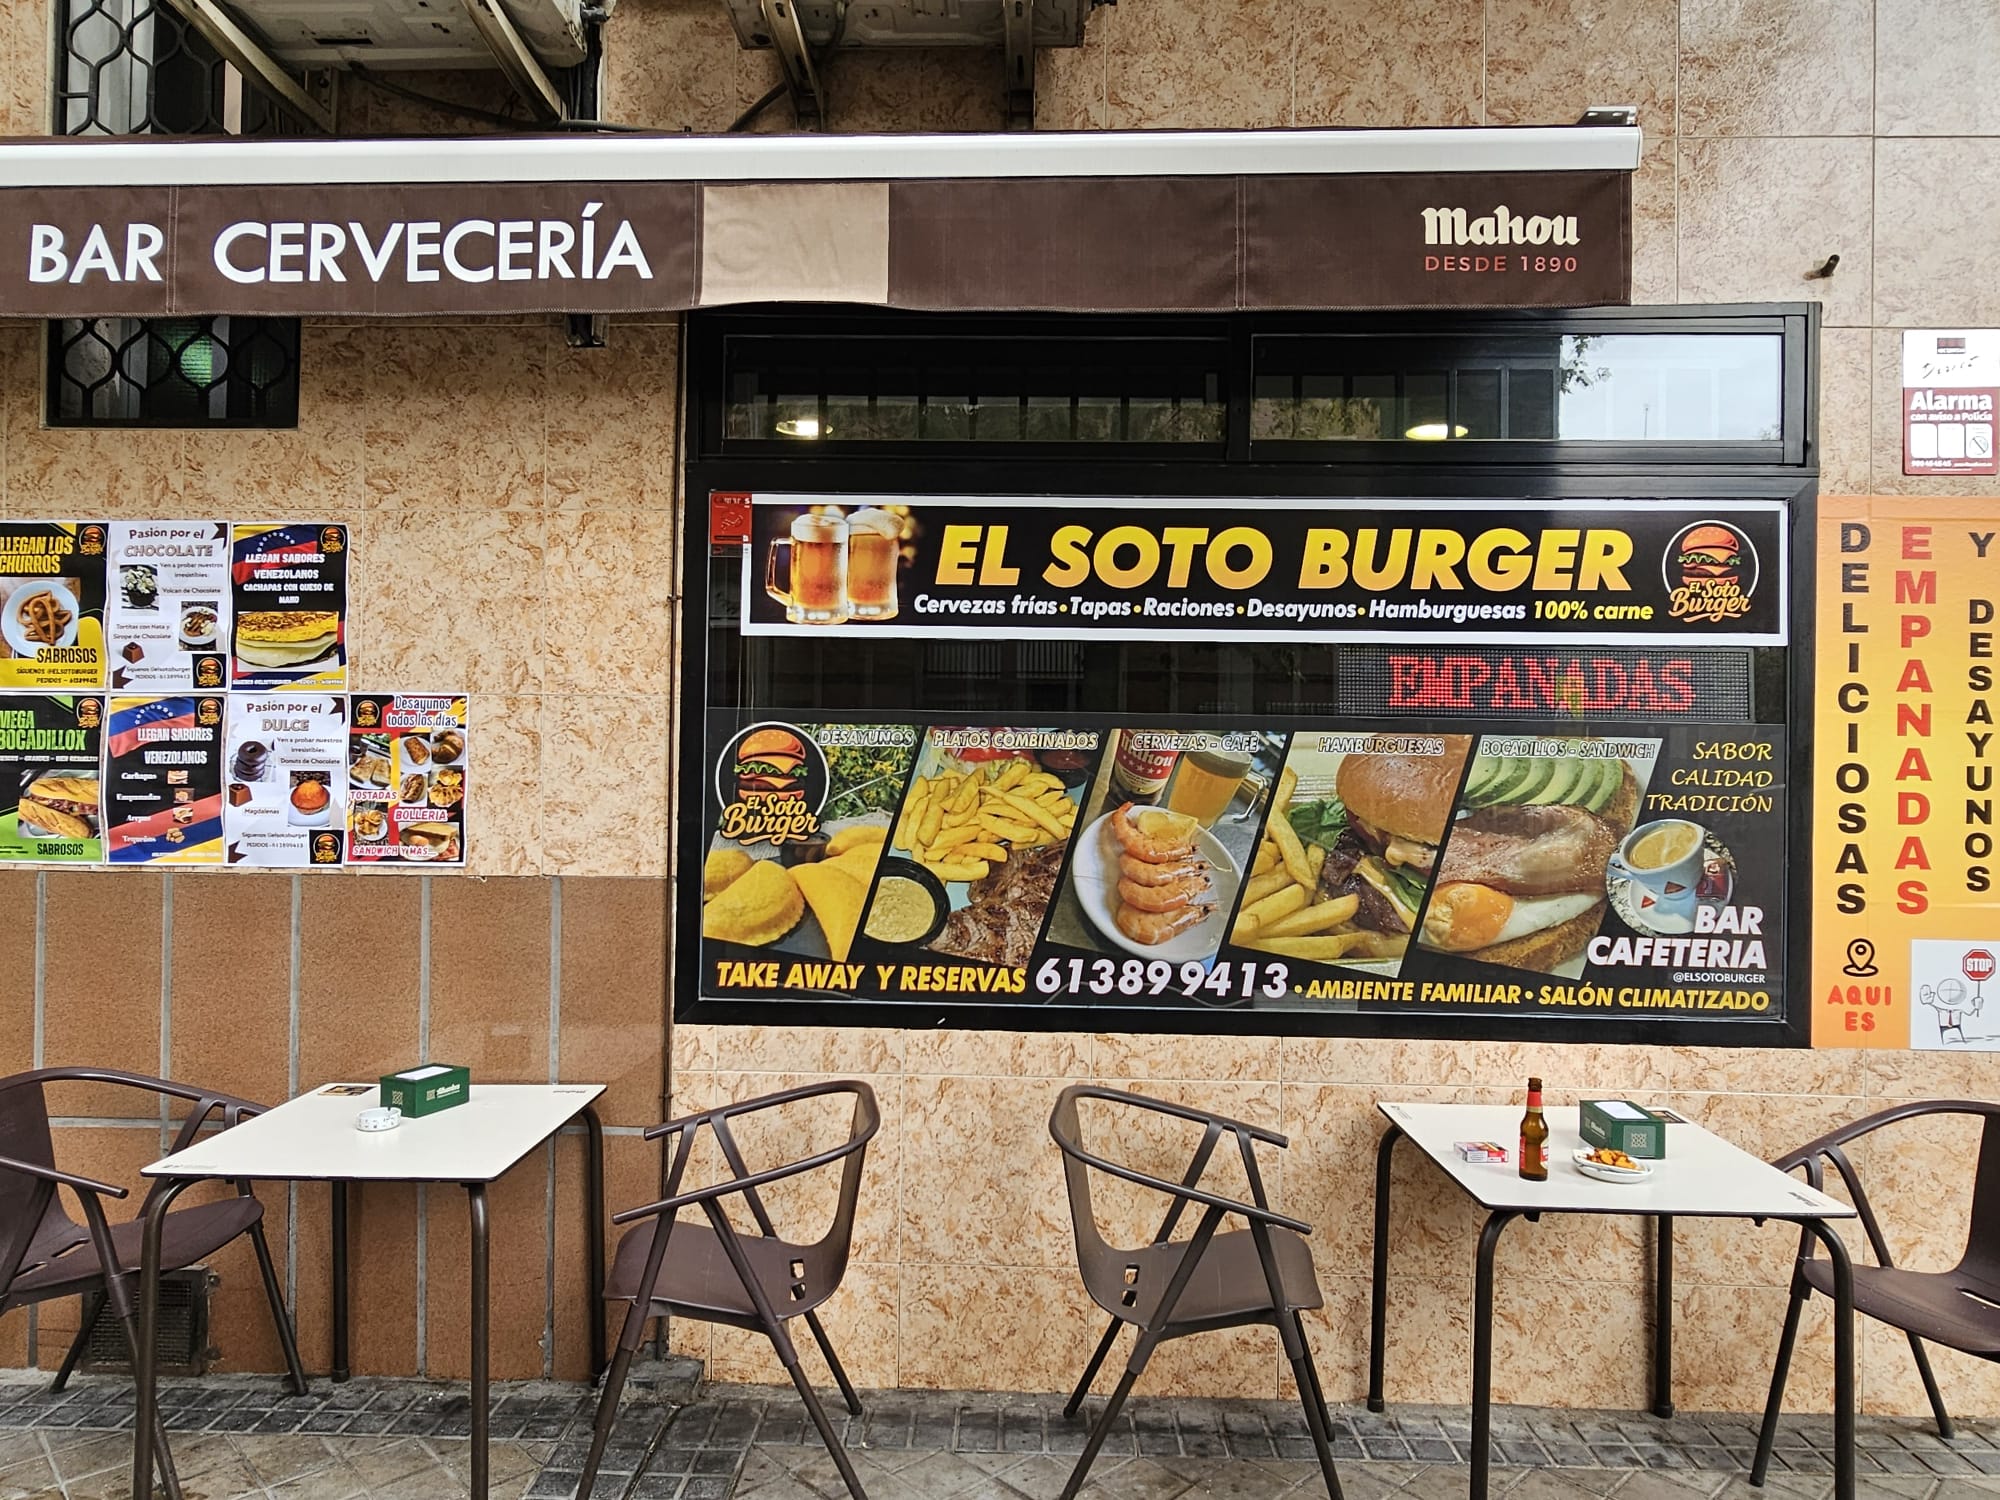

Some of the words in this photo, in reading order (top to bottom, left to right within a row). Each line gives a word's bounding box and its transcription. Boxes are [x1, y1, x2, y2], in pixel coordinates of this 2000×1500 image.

[1421, 205, 1581, 246] Mahou
[28, 224, 164, 284] BAR
[212, 202, 653, 284] CERVECERÍA
[1425, 256, 1507, 272] DESDE
[1521, 256, 1577, 272] 1890
[1910, 389, 1992, 411] Alarma
[1910, 413, 1927, 421] con
[169, 528, 192, 541] por
[193, 528, 206, 540] el
[48, 536, 74, 555] LOS
[124, 544, 214, 558] CHOCOLATE
[1968, 531, 1996, 558] Y
[0, 555, 61, 574] CHURROS
[245, 553, 280, 563] LLEGAN
[281, 553, 326, 563] SABORES
[935, 525, 1020, 586] EL
[1042, 525, 1273, 590] SOTO
[1298, 528, 1634, 592] BURGER
[253, 569, 320, 580] VENEZOLANOS
[1689, 582, 1702, 593] EL
[1702, 579, 1741, 598] Soto
[914, 595, 1005, 614] Cervezas
[1011, 595, 1058, 615] frías
[1070, 597, 1131, 620] Tapas
[1143, 597, 1235, 617] Raciones
[1247, 598, 1357, 622] Desayunos
[1369, 599, 1526, 624] Hamburguesas
[1534, 600, 1589, 620] 100%
[1593, 605, 1654, 620] carne
[1668, 587, 1752, 623] Burger
[36, 648, 97, 664] SABROSOS
[1389, 655, 1695, 710] EMPANADAS
[286, 702, 309, 714] por
[310, 702, 322, 714] el
[394, 696, 452, 712] Desayunos
[0, 710, 35, 729] MEGA
[261, 719, 310, 732] DULCE
[387, 713, 416, 726] todos
[417, 713, 433, 726] los
[435, 713, 458, 726] días
[1835, 522, 1871, 915] DELICIOSAS
[1894, 526, 1937, 915] EMPANADAS
[137, 727, 171, 742] LLEGAN
[171, 727, 214, 742] SABORES
[819, 729, 916, 747] DESAYUNOS
[933, 730, 991, 748] PLATOS
[992, 731, 1099, 750] COMBINADOS
[1132, 733, 1208, 752] CERVEZAS
[1220, 731, 1260, 753] CAFÉ
[1318, 737, 1445, 756] HAMBURGUESAS
[1480, 738, 1568, 757] BOCADILLOS
[1578, 741, 1656, 759] SANDWICH
[1693, 741, 1773, 761] SABOR
[1964, 598, 1996, 893] DESAYUNOS
[144, 750, 208, 764] VENEZOLANOS
[1671, 769, 1773, 788] CALIDAD
[350, 791, 397, 800] TOSTADAS
[746, 796, 762, 810] EL
[761, 793, 808, 816] Soto
[1646, 793, 1773, 813] TRADICIÓN
[394, 809, 448, 821] BOLLERIA
[721, 802, 820, 846] Burger
[37, 843, 84, 855] SABROSOS
[353, 846, 398, 856] SANDWICH
[1694, 905, 1764, 936] BAR
[1587, 936, 1768, 969] CAFETERIA
[1966, 958, 1992, 972] STOP
[716, 962, 780, 987] TAKE
[784, 964, 865, 990] AWAY
[876, 965, 896, 990] Y
[899, 966, 1027, 994] RESERVAS
[1305, 979, 1415, 1001] AMBIENTE
[1420, 982, 1522, 1004] FAMILIAR
[1538, 981, 1614, 1007] SALÓN
[1618, 986, 1770, 1011] CLIMATIZADO
[1672, 972, 1766, 984] @ELSOTOBURGER
[1827, 984, 1892, 1006] AQUI
[1844, 1011, 1875, 1032] ES
